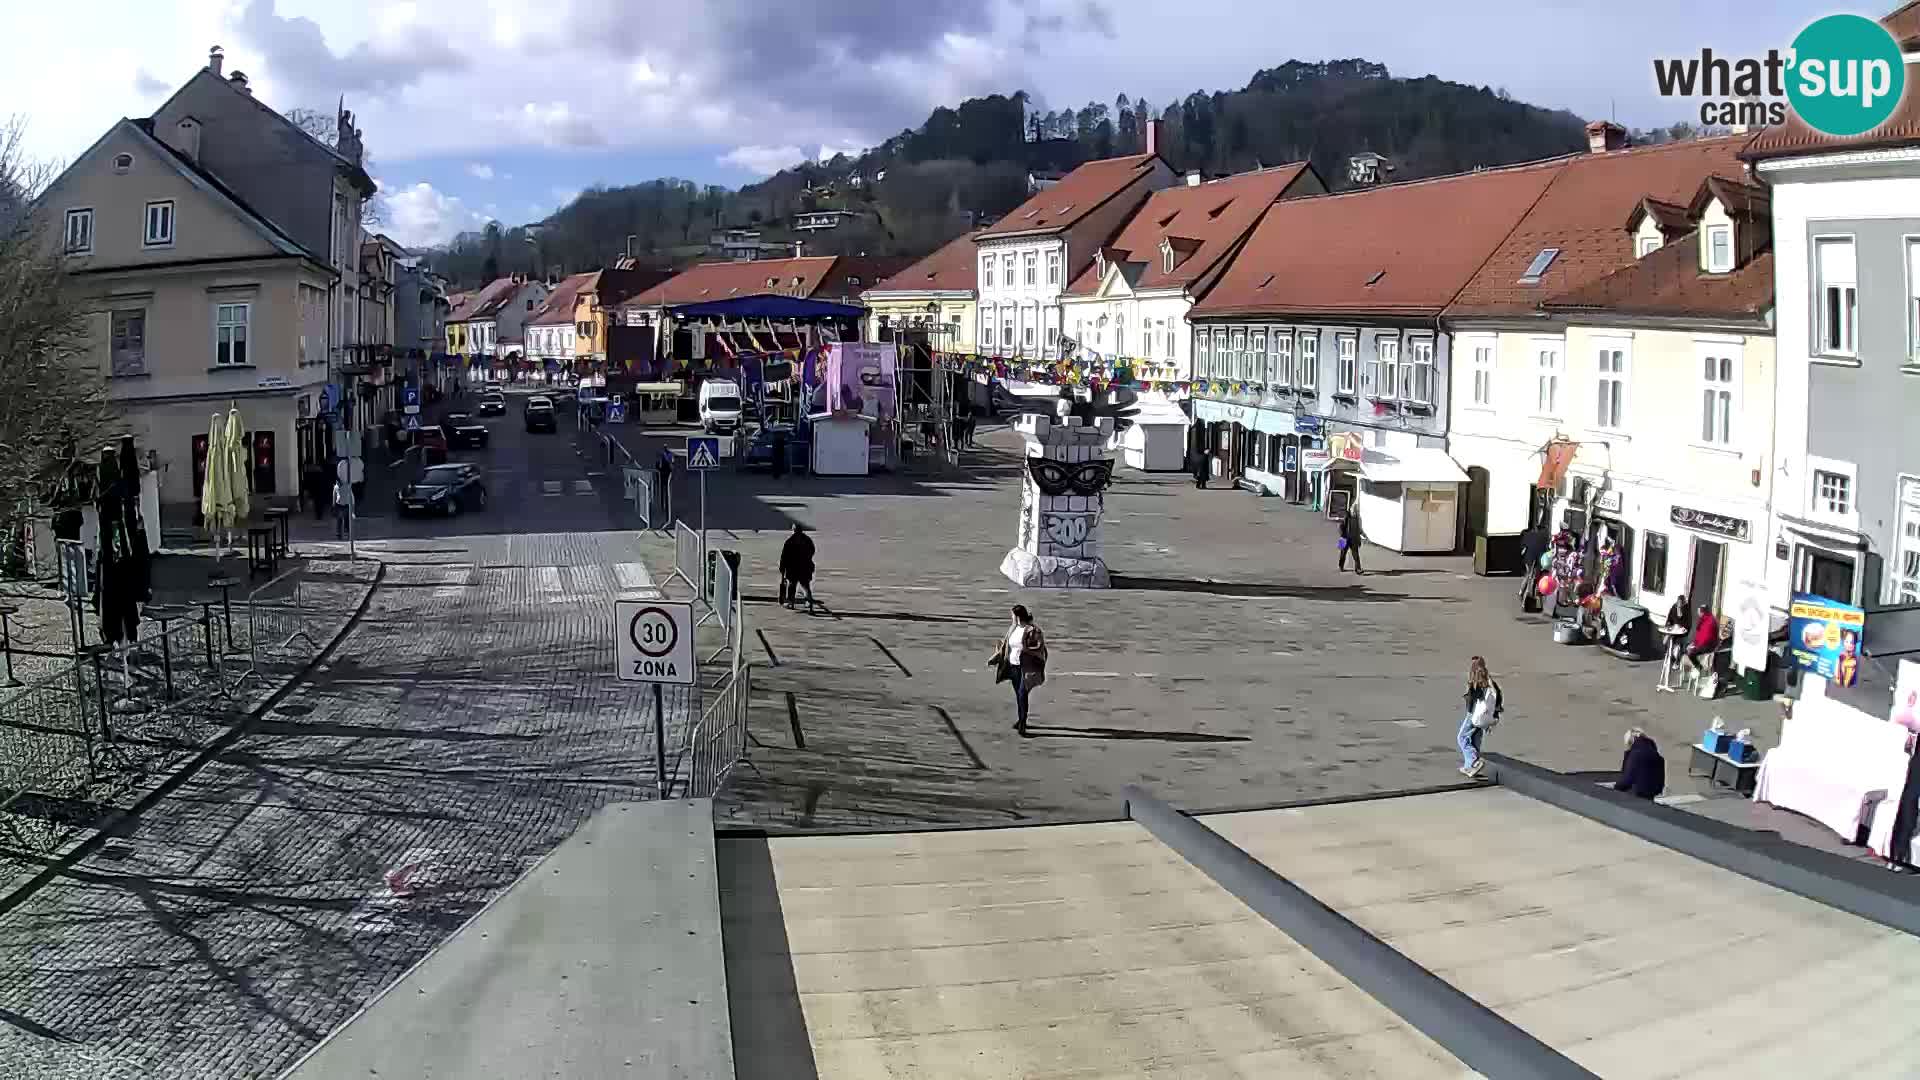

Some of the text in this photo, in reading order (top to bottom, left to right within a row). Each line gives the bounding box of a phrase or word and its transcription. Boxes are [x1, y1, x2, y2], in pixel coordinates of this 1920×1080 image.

[407, 391, 416, 403] P
[642, 622, 667, 644] 30
[632, 659, 678, 678] ZONA
